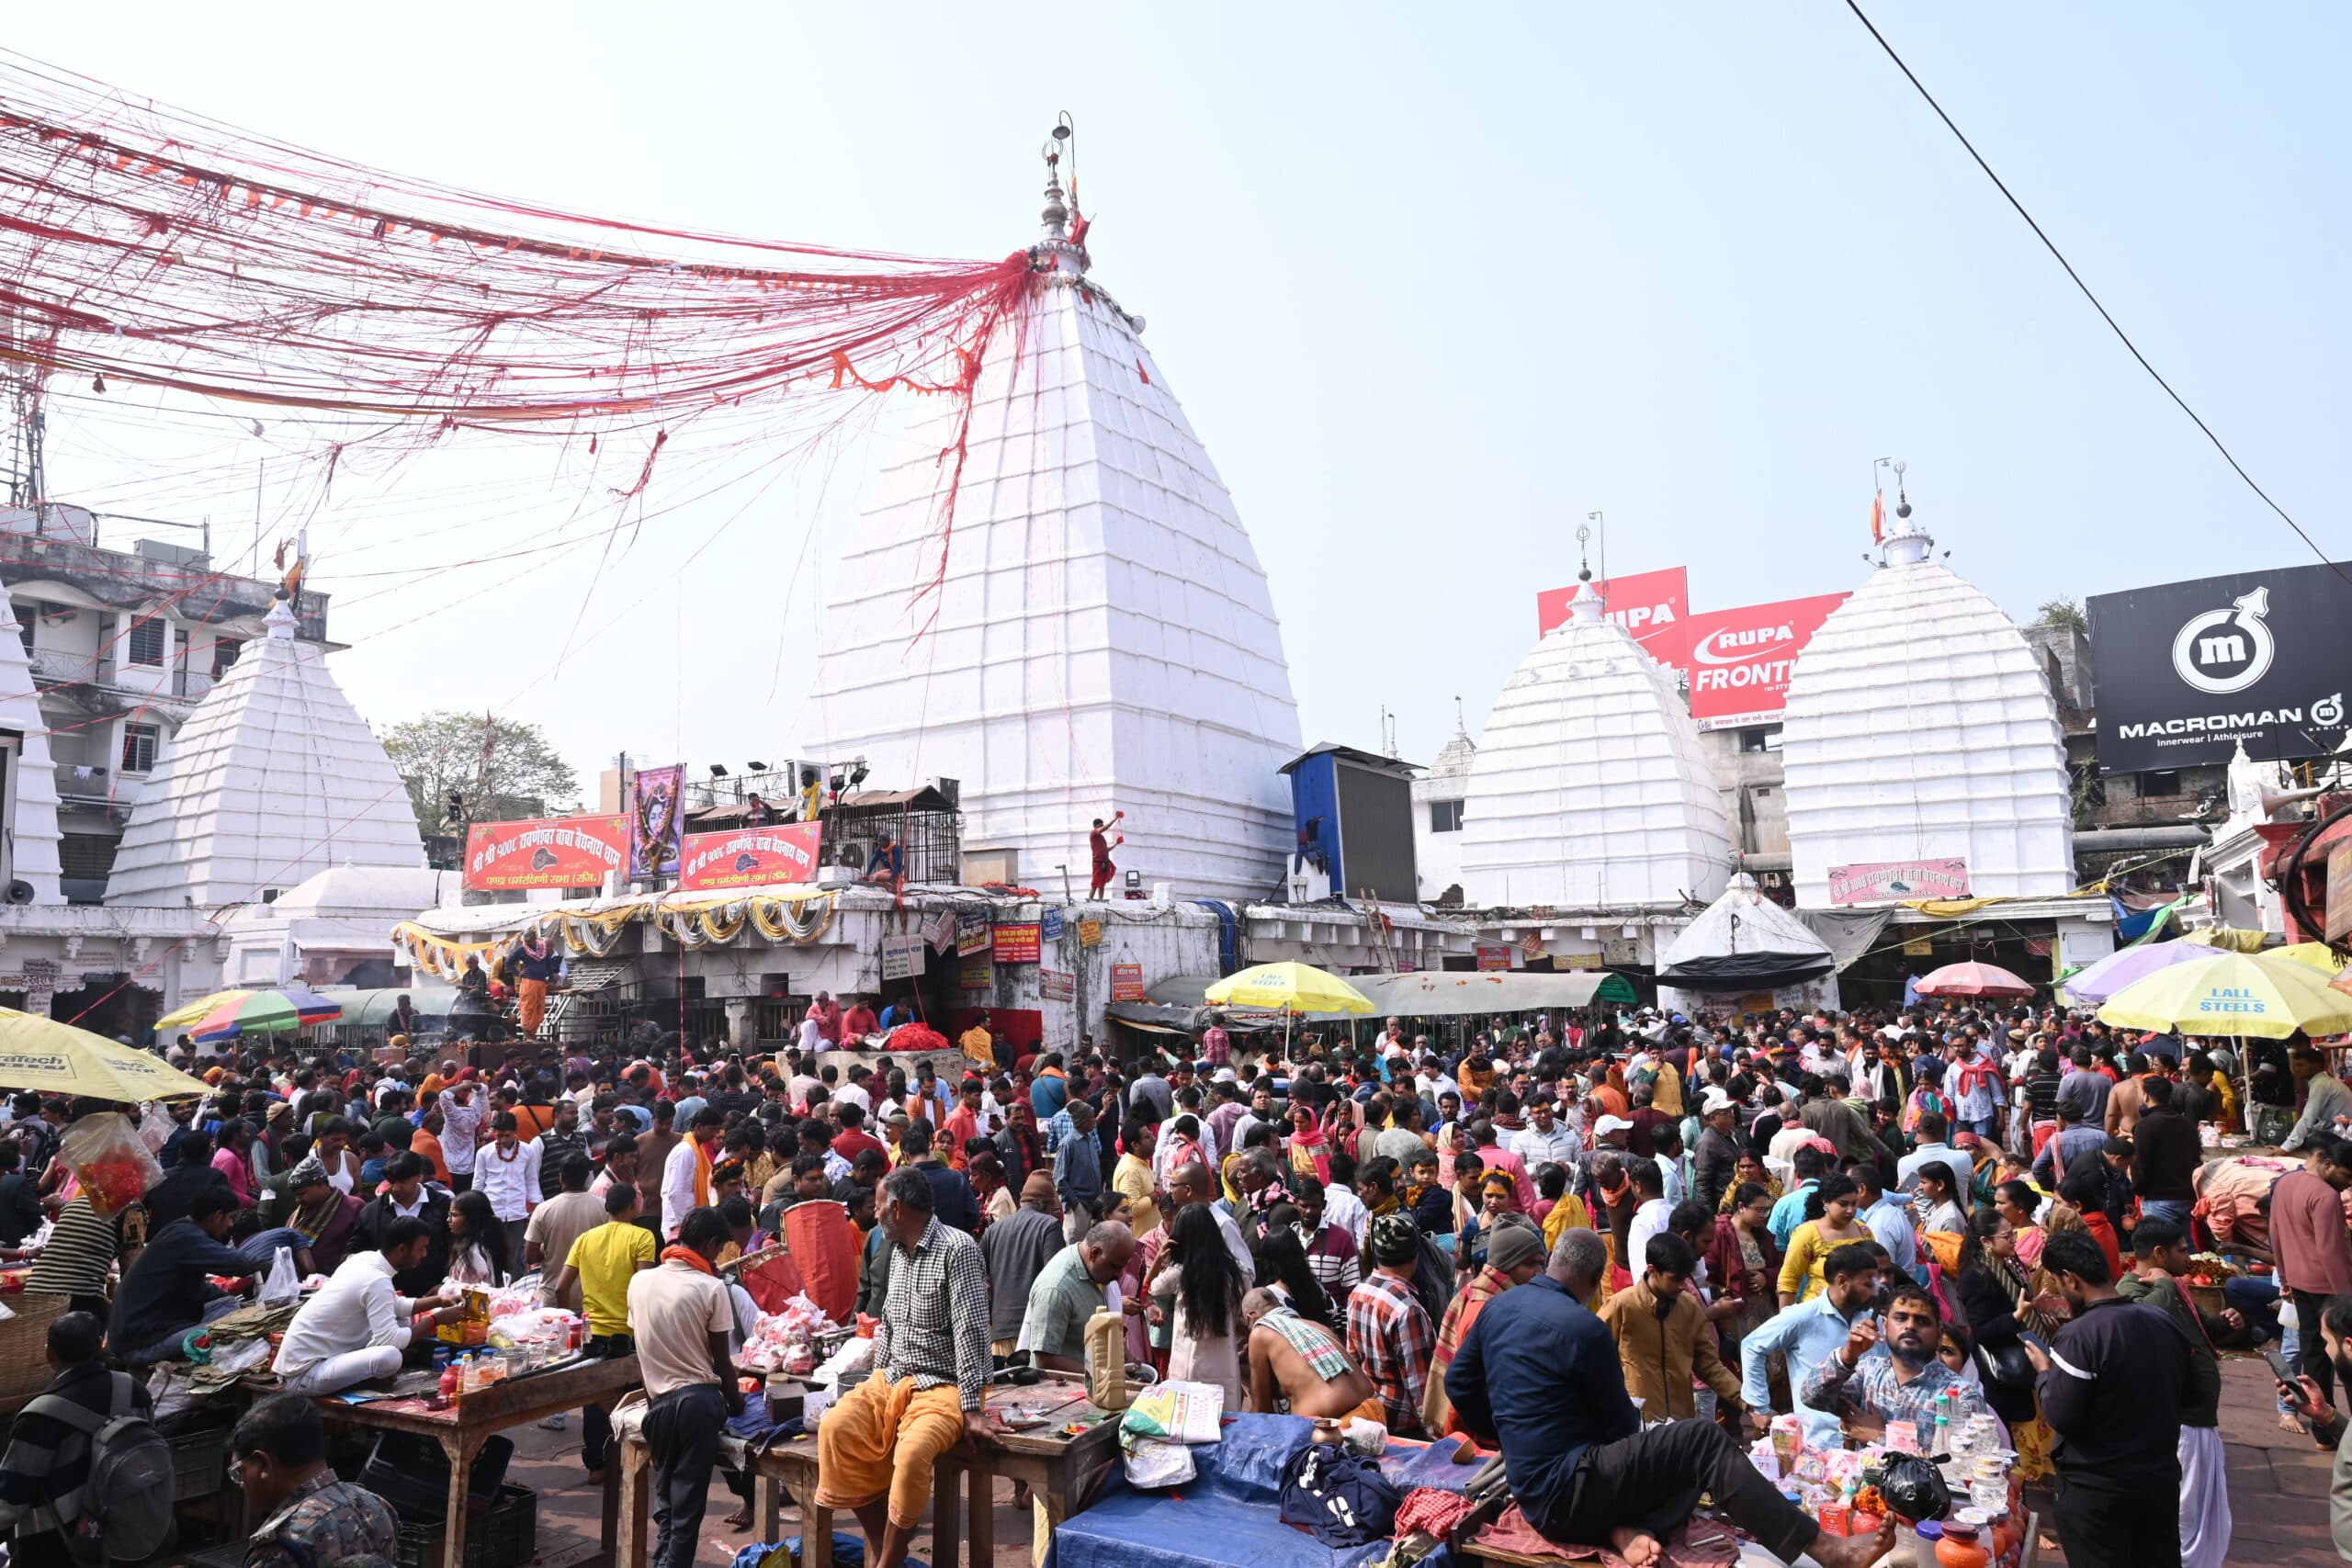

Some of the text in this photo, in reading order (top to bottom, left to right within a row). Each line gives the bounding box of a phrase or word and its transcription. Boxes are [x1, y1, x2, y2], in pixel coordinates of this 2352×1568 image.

[1605, 603, 1676, 631] UPA
[1719, 625, 1794, 649] RUPA
[2199, 635, 2246, 664] m
[2119, 707, 2302, 739] MACROMAN
[2157, 730, 2264, 747] Innerwear Athleisure
[472, 851, 484, 873] श्री
[485, 843, 496, 865] श्री
[556, 828, 574, 848] बाबा
[756, 836, 771, 852] बाबा
[550, 874, 570, 883] सभा
[2211, 987, 2254, 998] LALL
[2199, 1001, 2266, 1013] STEELS
